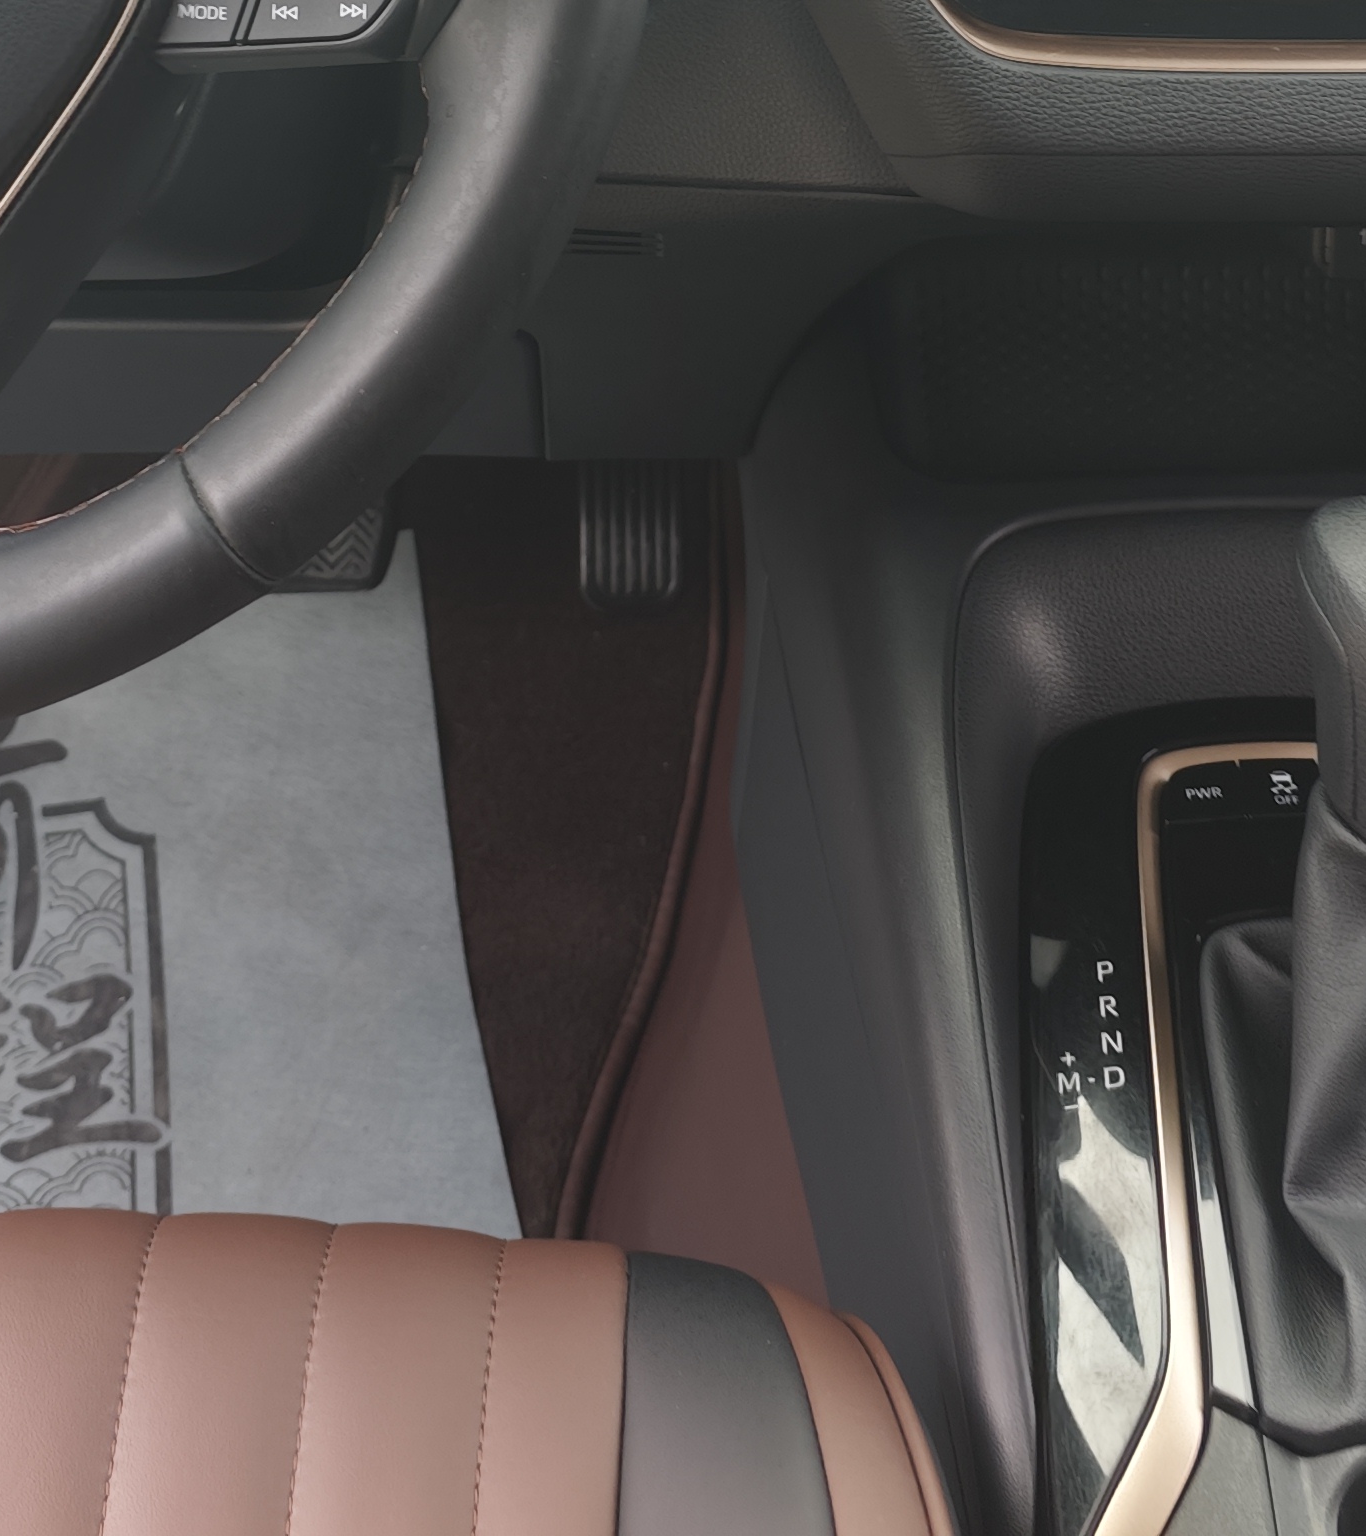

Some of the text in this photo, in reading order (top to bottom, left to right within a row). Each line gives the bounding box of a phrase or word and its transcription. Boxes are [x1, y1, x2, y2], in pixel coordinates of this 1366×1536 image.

[177, 3, 228, 21] MODE
[1184, 786, 1223, 800] PWR
[1273, 794, 1299, 806] OFF
